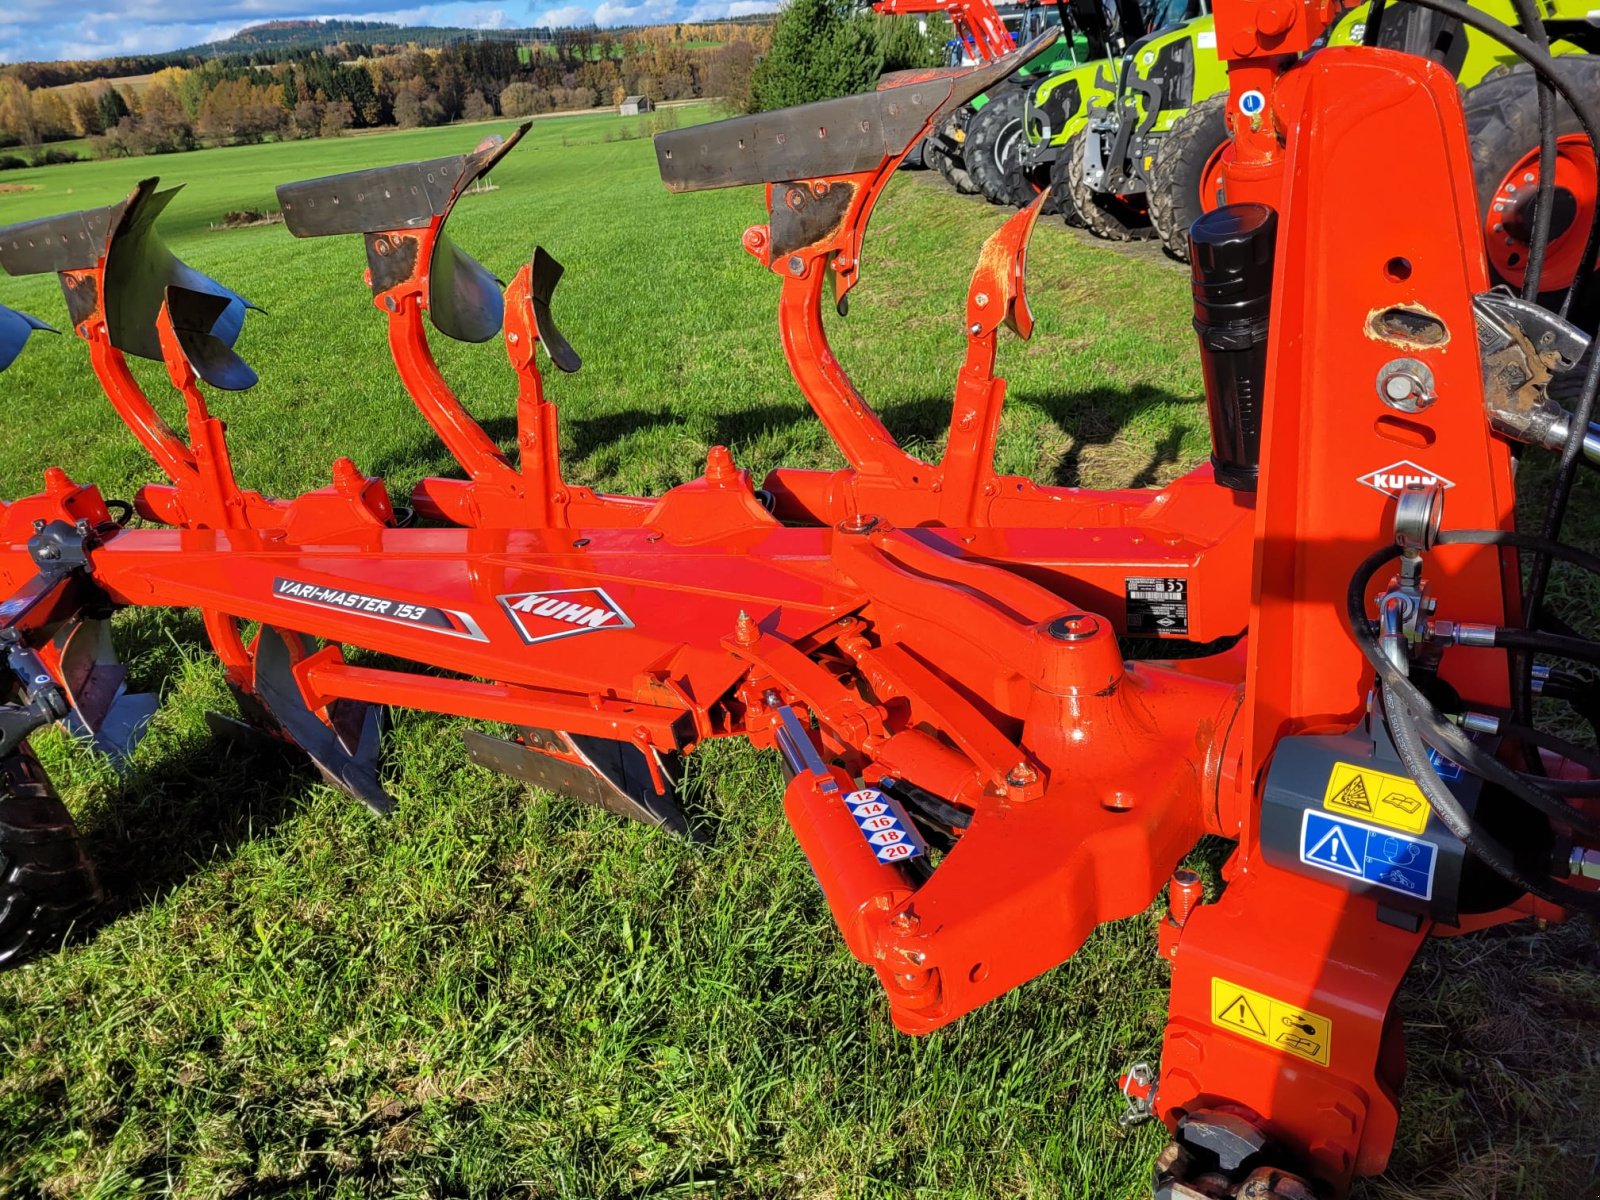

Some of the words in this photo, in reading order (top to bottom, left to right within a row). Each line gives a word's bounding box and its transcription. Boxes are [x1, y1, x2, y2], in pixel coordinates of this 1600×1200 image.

[1373, 473, 1437, 489] KUHN
[278, 580, 391, 614] VARI-MASTER
[393, 603, 427, 620] 153
[510, 594, 617, 628] KUHN
[854, 791, 874, 801] 12
[862, 804, 882, 815] 14
[870, 817, 891, 829] 16
[878, 831, 899, 843] 18
[886, 845, 908, 858] 20
